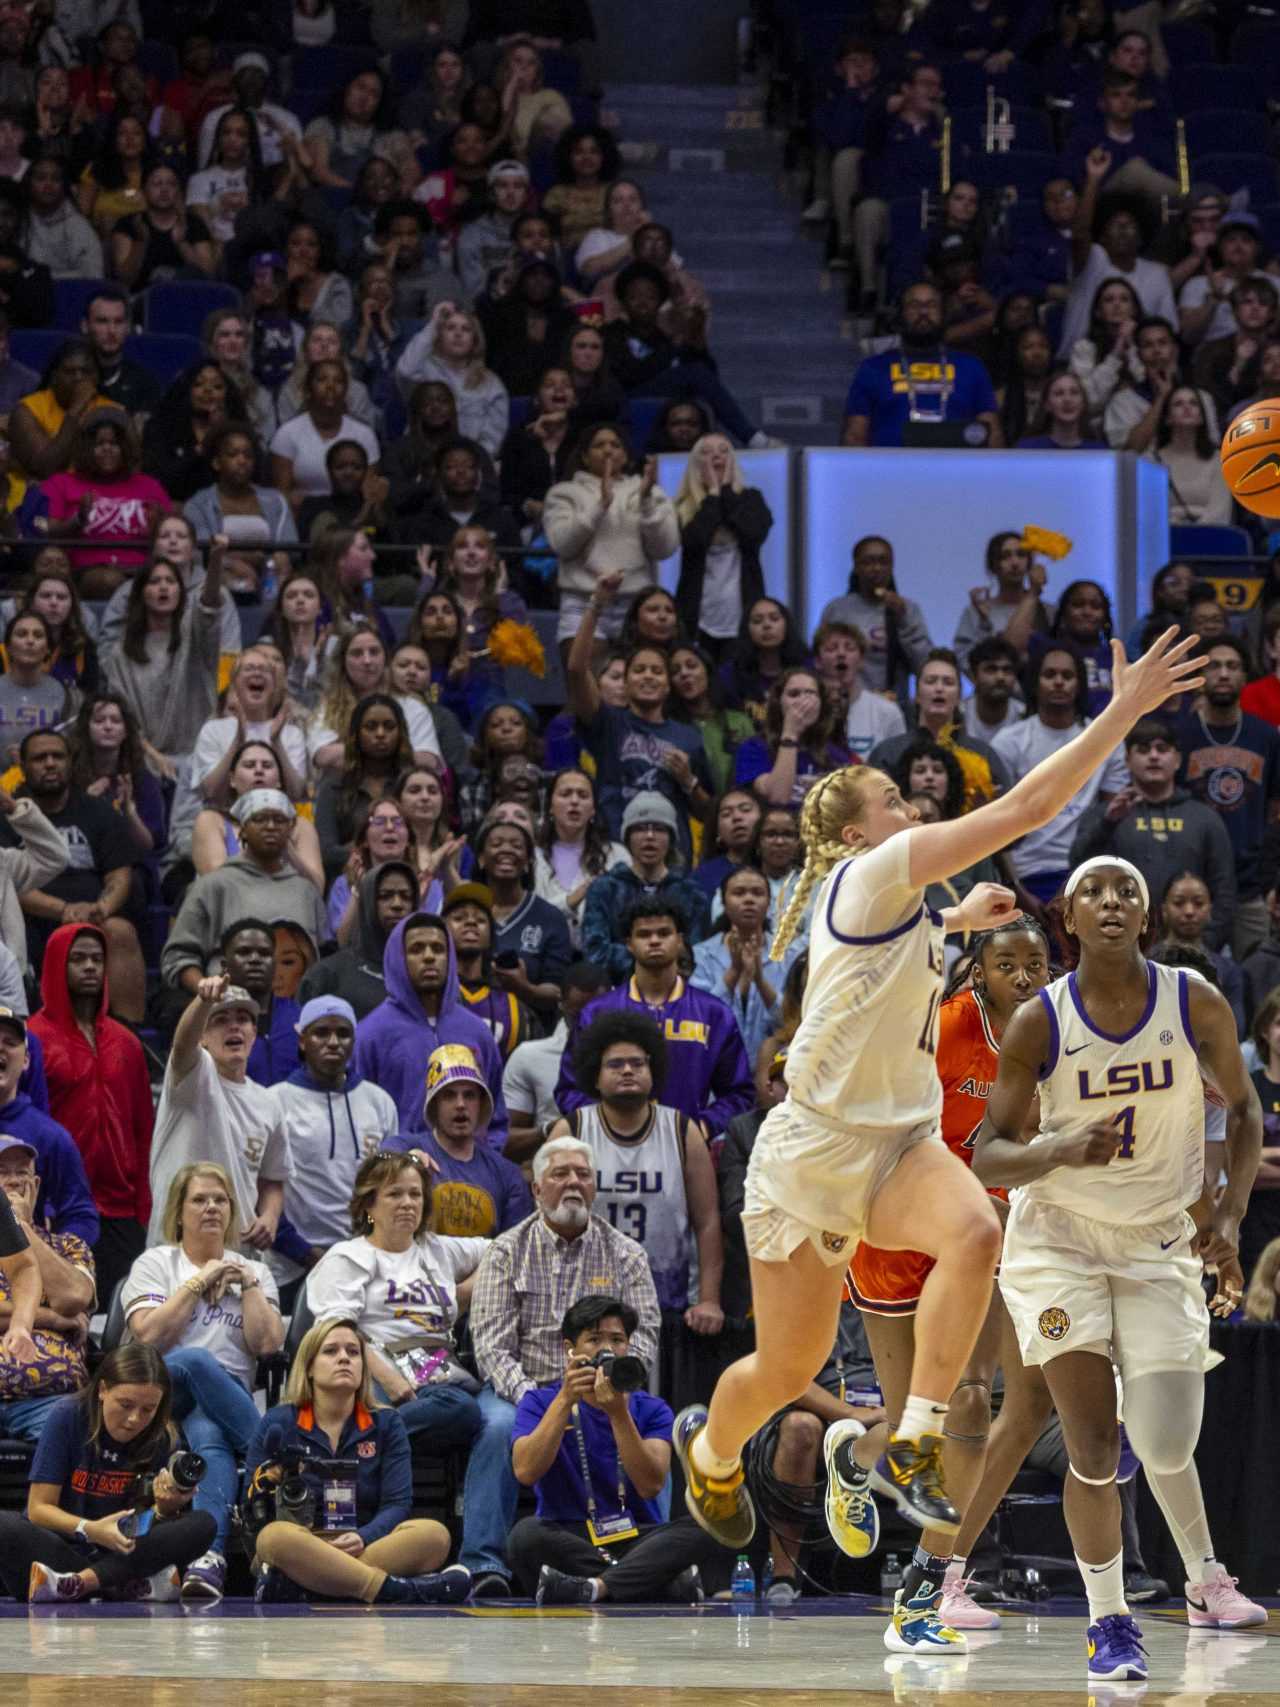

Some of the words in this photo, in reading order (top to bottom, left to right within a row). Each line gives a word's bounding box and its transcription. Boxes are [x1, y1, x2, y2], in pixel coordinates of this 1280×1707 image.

[891, 362, 955, 381] LSU
[1136, 817, 1184, 832] LSU
[665, 1018, 711, 1048] LSU
[1077, 1059, 1174, 1101] LSU
[1113, 1105, 1137, 1159] 4
[597, 1171, 664, 1193] LSU
[607, 1202, 648, 1243] 13
[380, 1278, 451, 1306] LSU
